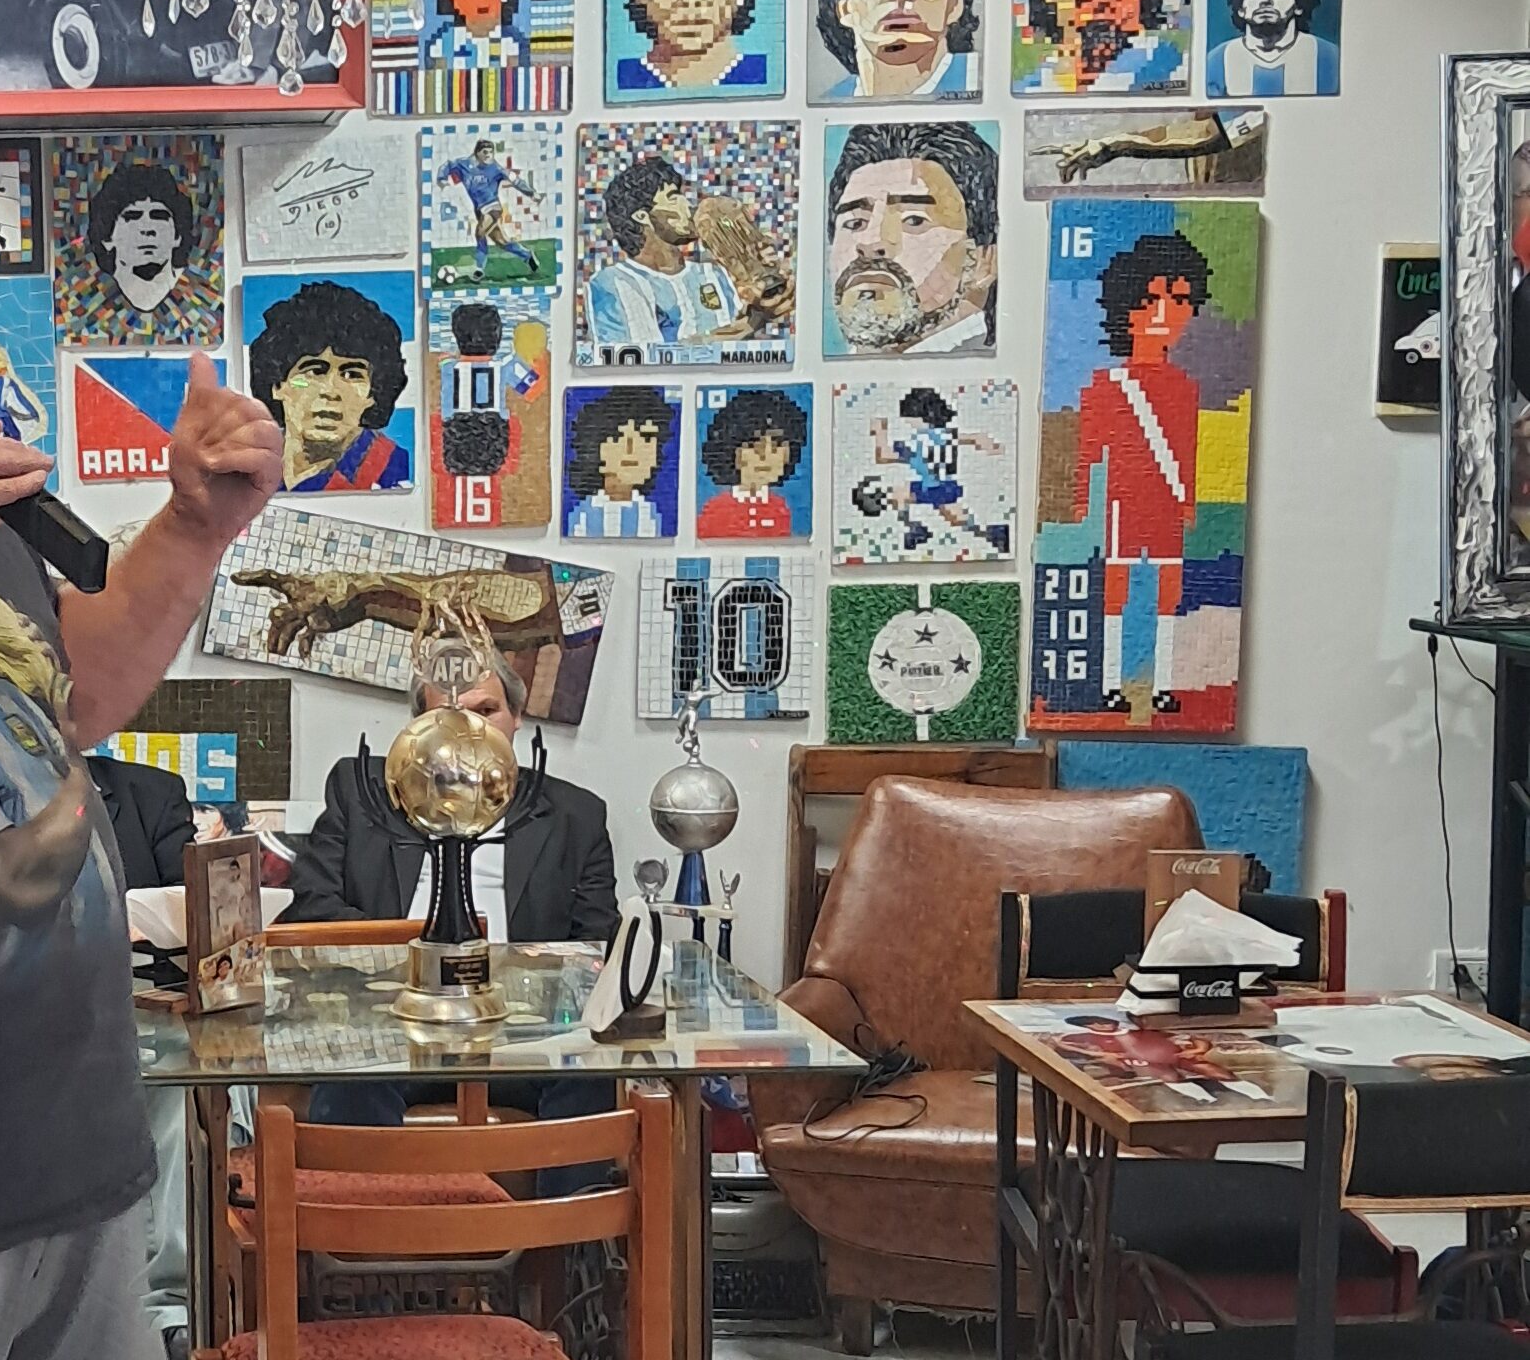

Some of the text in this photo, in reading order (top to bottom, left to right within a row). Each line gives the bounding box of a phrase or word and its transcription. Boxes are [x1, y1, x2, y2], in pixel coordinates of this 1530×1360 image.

[1060, 227, 1094, 259] 16
[721, 349, 788, 364] MARADONA
[452, 367, 495, 409] 10
[454, 475, 492, 523] 16
[1044, 569, 1089, 601] 20
[665, 577, 793, 693] 10
[1049, 610, 1089, 641] 10
[1042, 649, 1088, 681] 76
